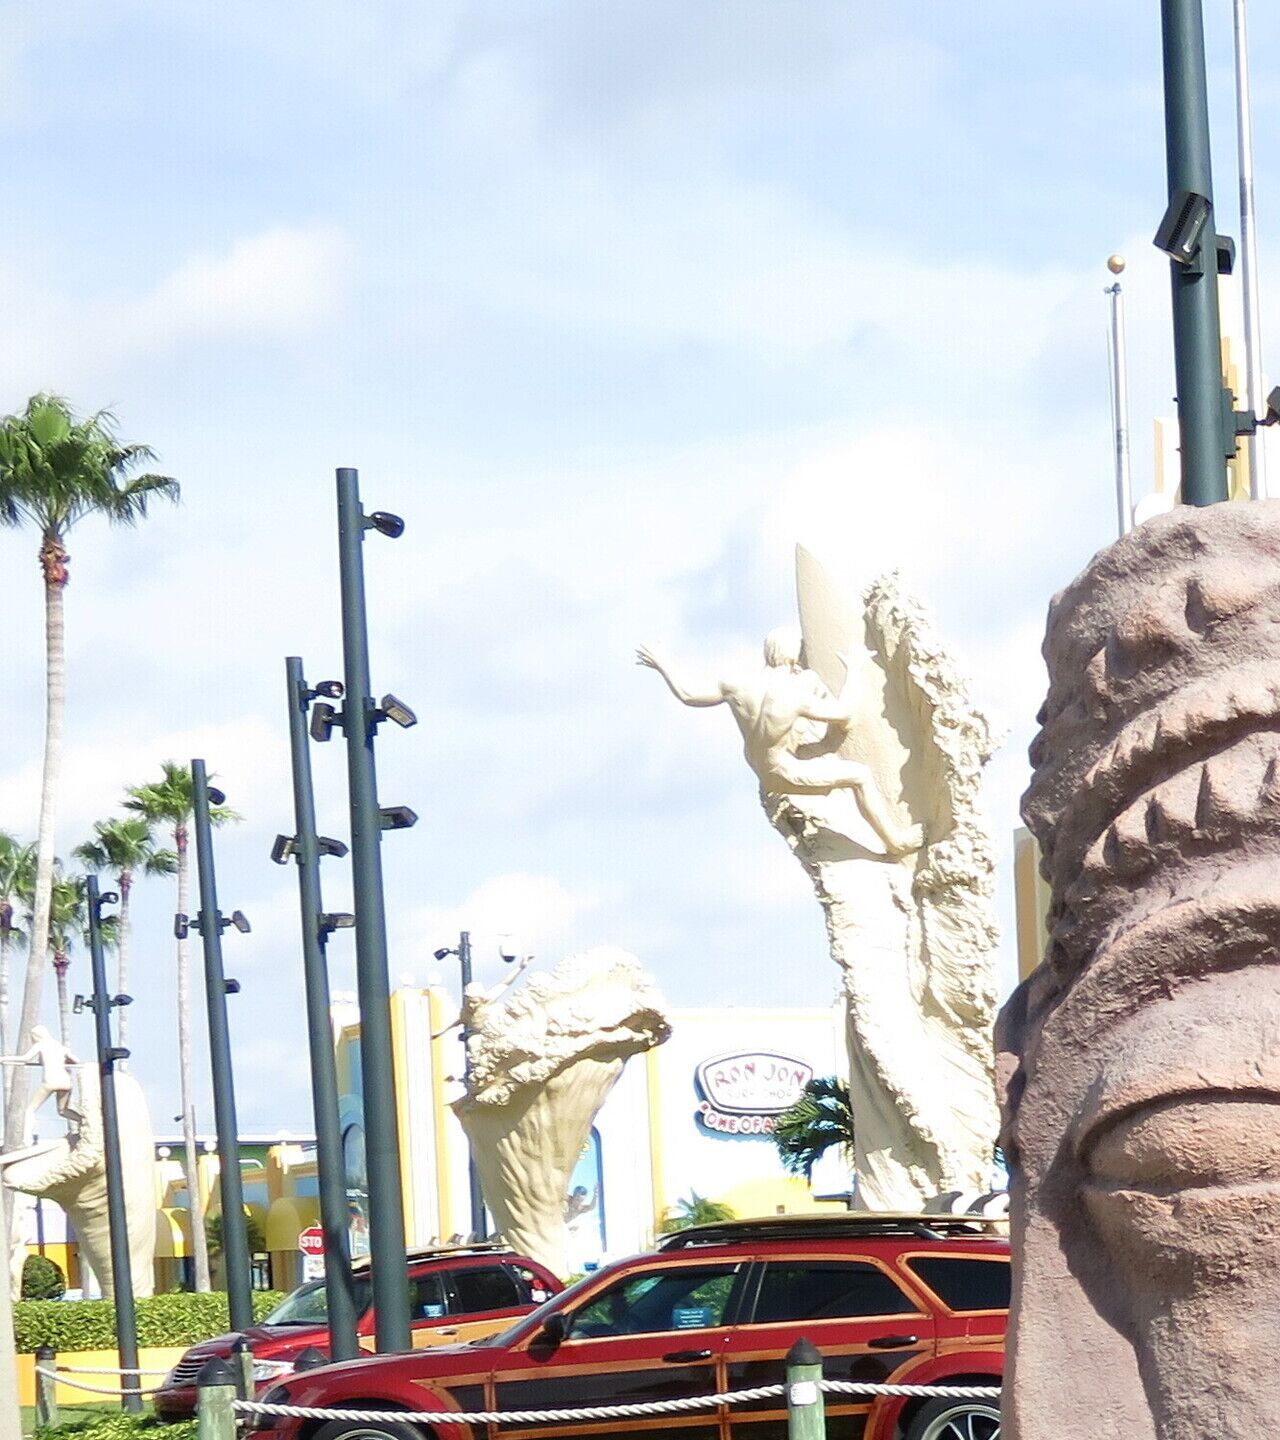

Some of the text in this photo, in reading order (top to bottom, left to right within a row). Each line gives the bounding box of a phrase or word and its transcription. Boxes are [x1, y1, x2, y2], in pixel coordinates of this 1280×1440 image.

[714, 1062, 805, 1088] RON JON
[706, 1112, 737, 1130] ONE
[741, 1117, 760, 1132] OF
[301, 1236, 322, 1248] STO
